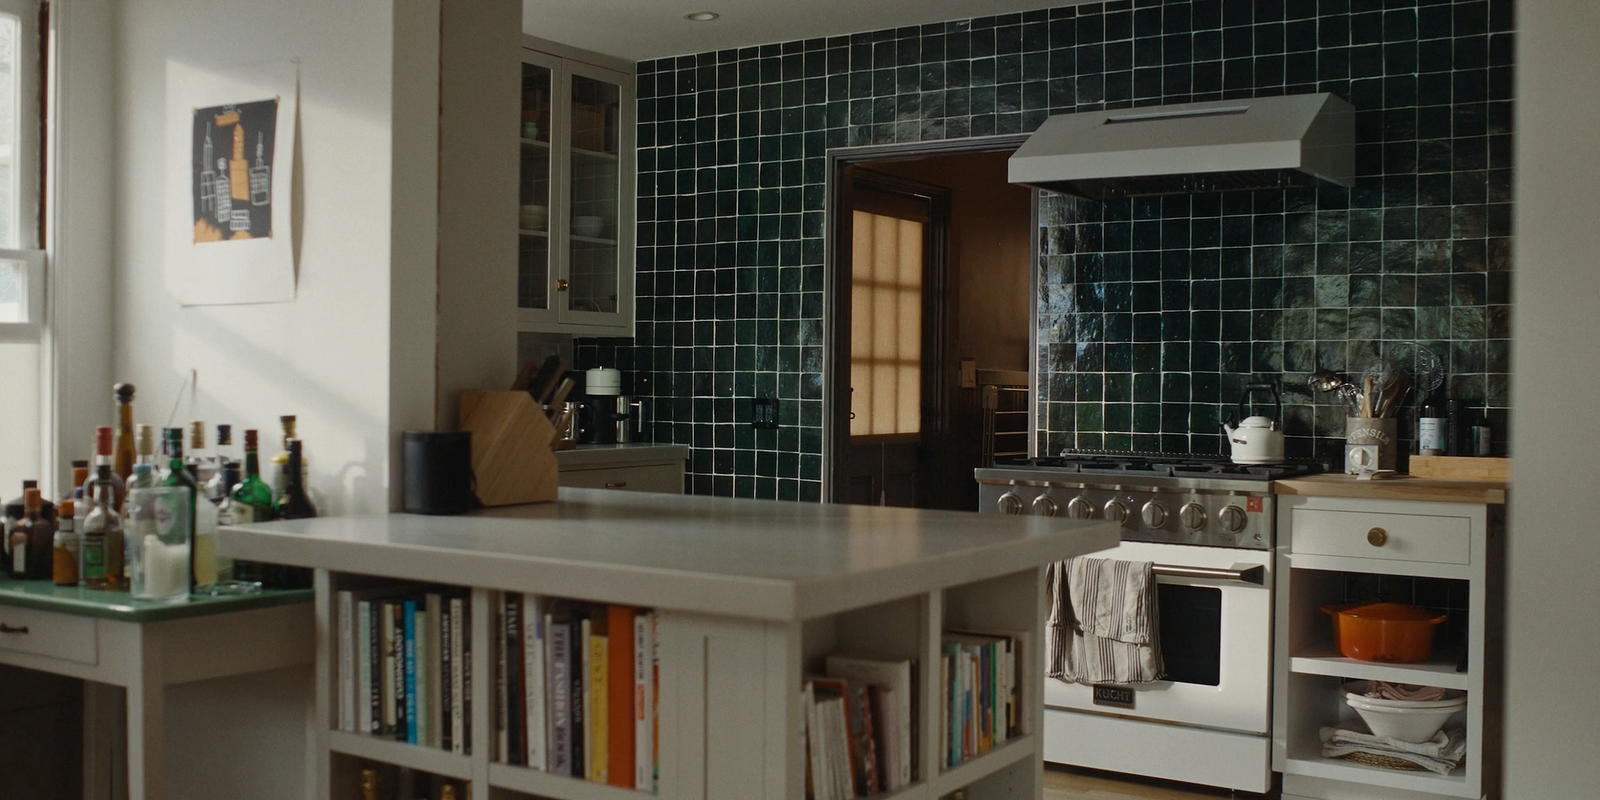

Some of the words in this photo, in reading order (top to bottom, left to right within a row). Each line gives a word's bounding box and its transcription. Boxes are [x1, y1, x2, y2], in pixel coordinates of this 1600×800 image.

[1347, 427, 1391, 445] UTENSILS
[507, 603, 516, 639] TIME
[554, 660, 567, 728] FASHION
[1095, 688, 1131, 700] KUCHT
